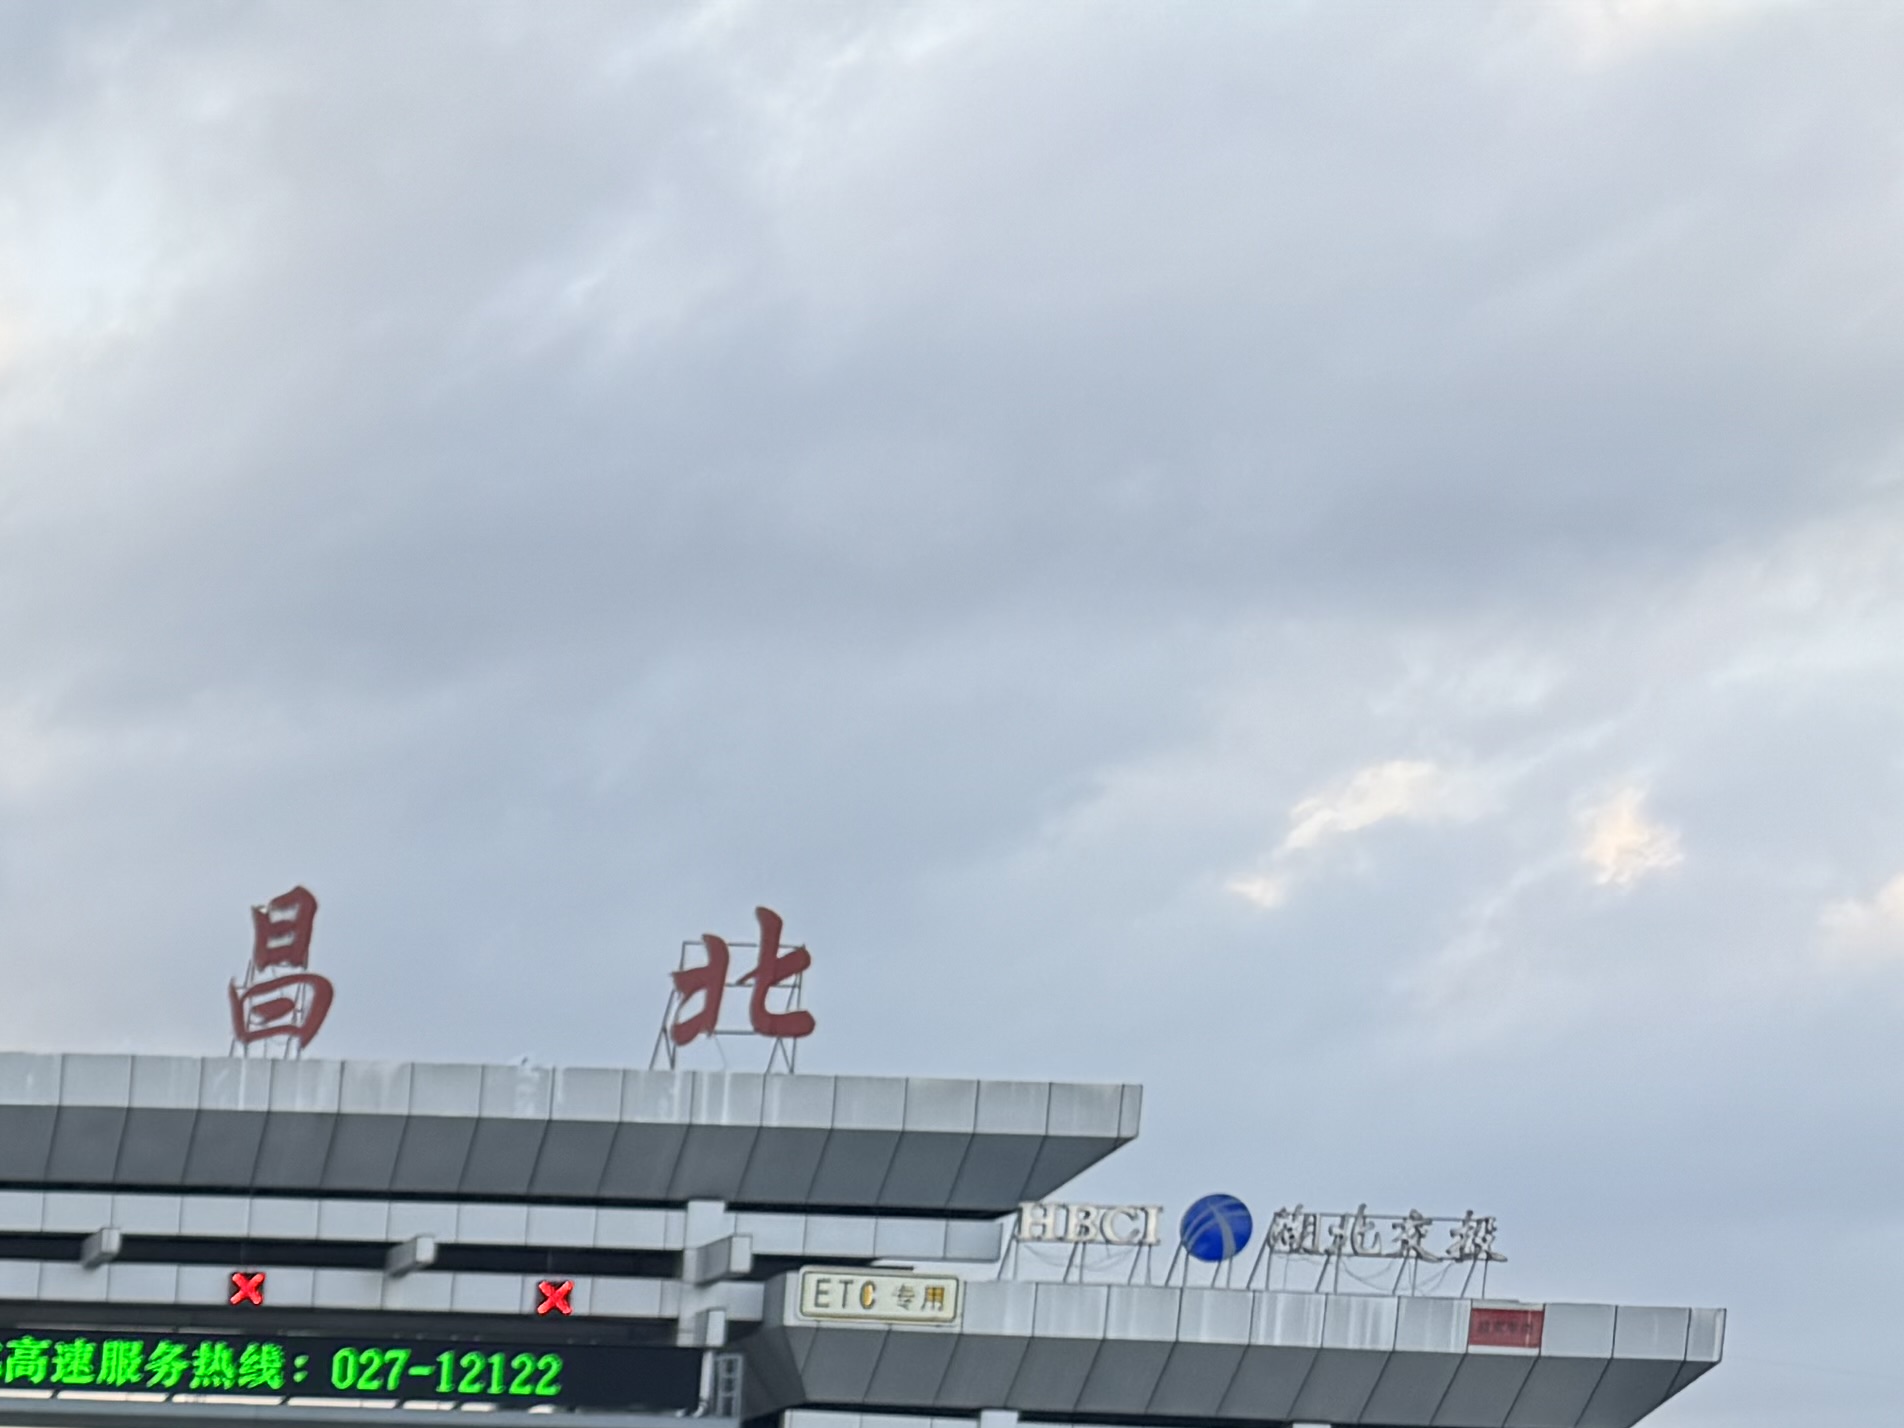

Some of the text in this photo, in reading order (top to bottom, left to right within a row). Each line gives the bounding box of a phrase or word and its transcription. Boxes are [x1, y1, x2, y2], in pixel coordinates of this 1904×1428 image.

[1019, 1202, 1163, 1246] HBCI
[1270, 1203, 1508, 1263] 湖北交投
[814, 1278, 876, 1310] ETC
